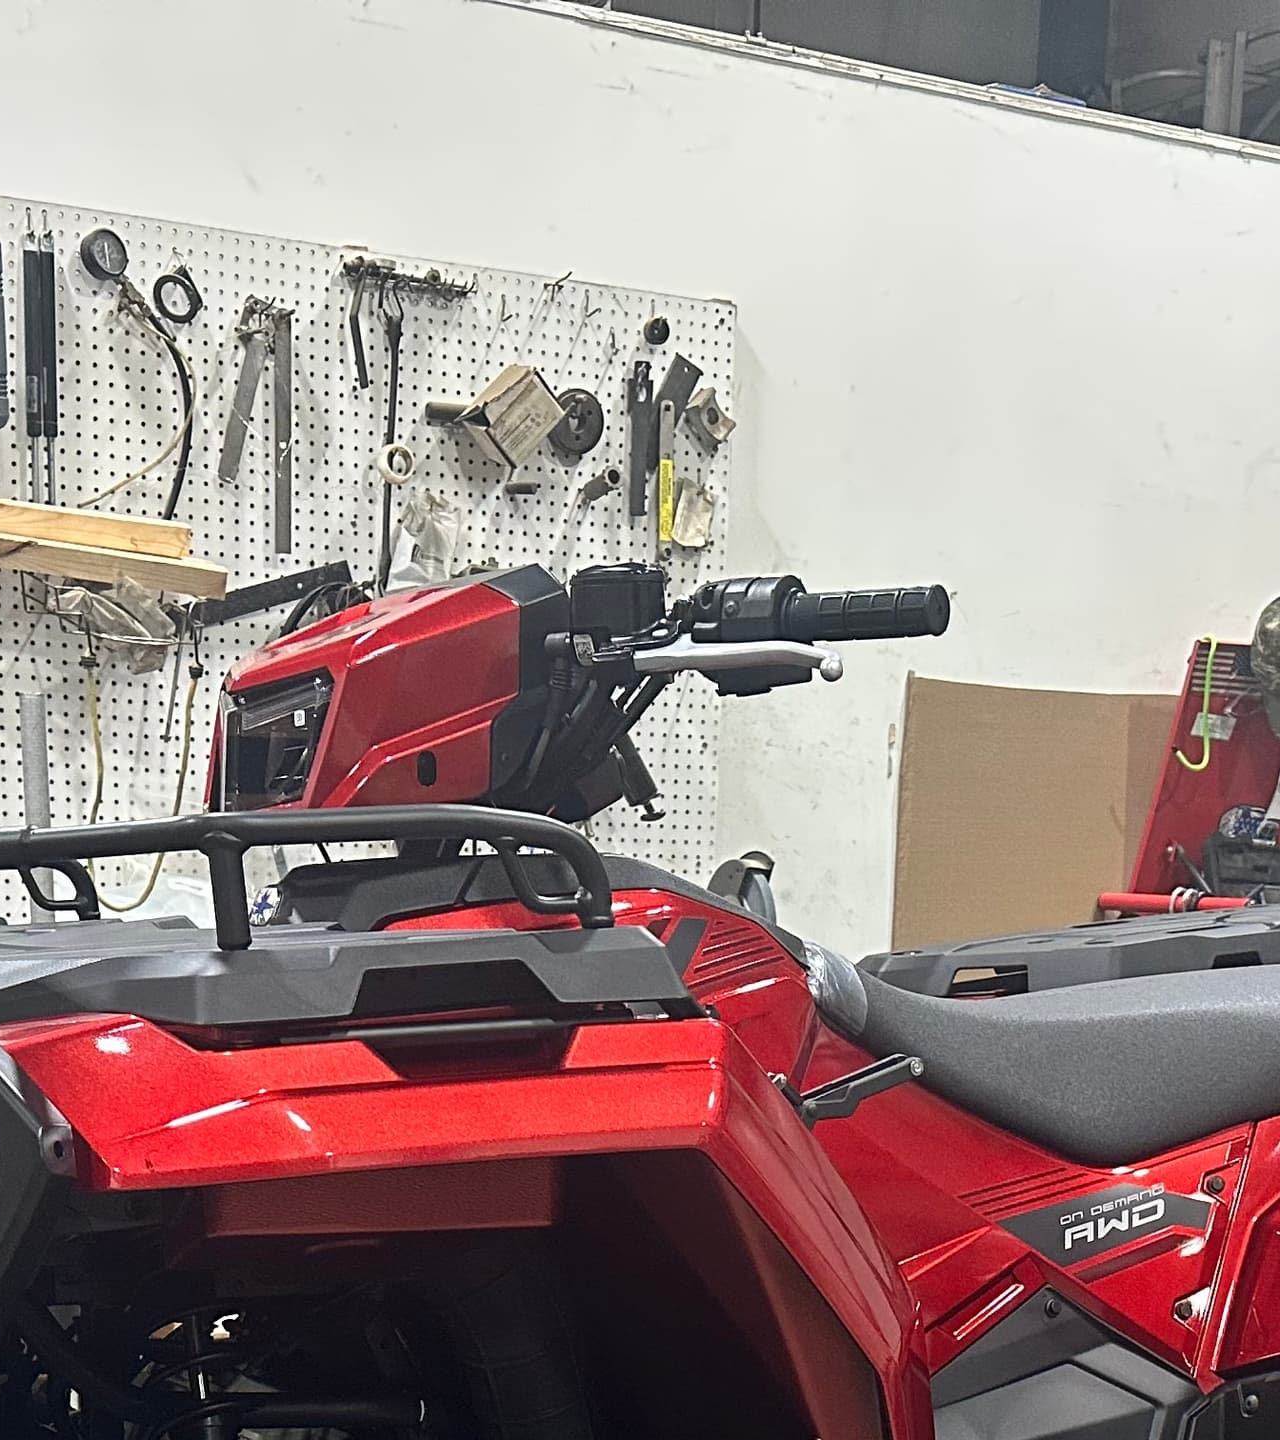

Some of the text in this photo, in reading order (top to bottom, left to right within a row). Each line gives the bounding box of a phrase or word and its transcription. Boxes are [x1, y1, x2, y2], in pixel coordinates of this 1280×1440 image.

[1060, 1182, 1165, 1225] ON DEMAND
[1064, 1198, 1165, 1250] AWD
